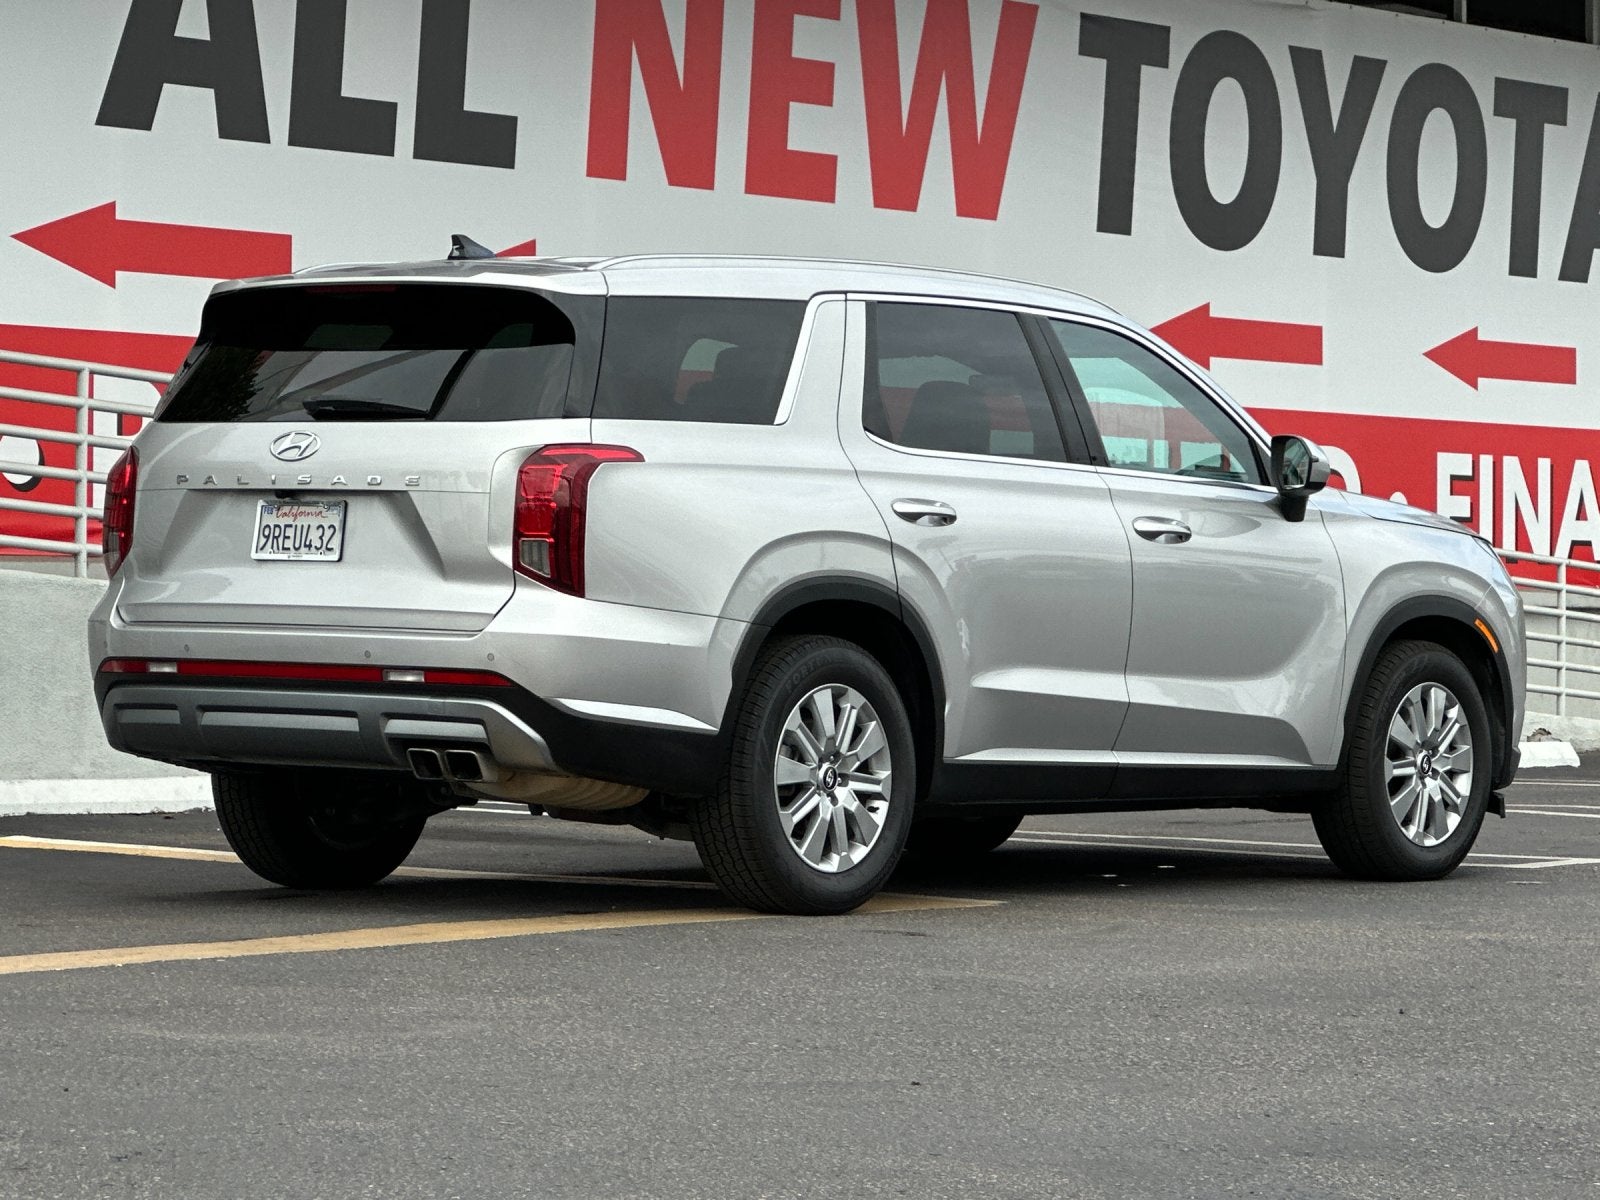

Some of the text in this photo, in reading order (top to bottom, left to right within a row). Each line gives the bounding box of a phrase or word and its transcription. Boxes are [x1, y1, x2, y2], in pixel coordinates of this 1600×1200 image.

[97, 0, 518, 168] ALL
[586, 0, 1038, 219] NEW
[176, 474, 420, 486] PALISADE
[275, 505, 328, 522] California
[1436, 451, 1600, 563] FINA
[259, 524, 337, 551] 9REU432
